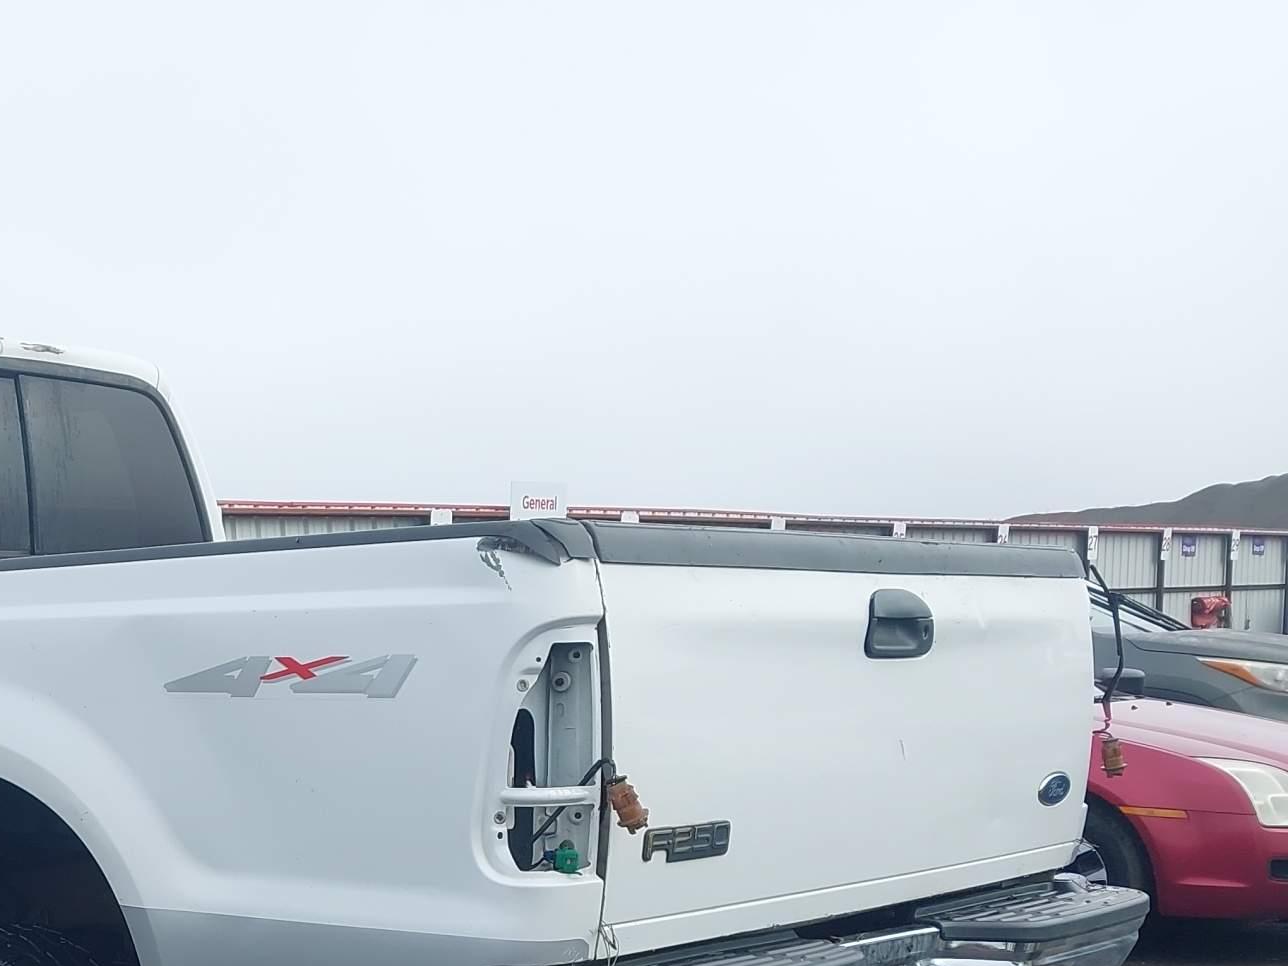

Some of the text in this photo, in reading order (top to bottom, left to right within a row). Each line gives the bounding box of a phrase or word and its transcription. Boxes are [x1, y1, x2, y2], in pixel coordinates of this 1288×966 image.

[522, 495, 558, 510] General
[1088, 535, 1098, 551] 27
[1162, 536, 1171, 551] 28
[1231, 538, 1240, 551] 29
